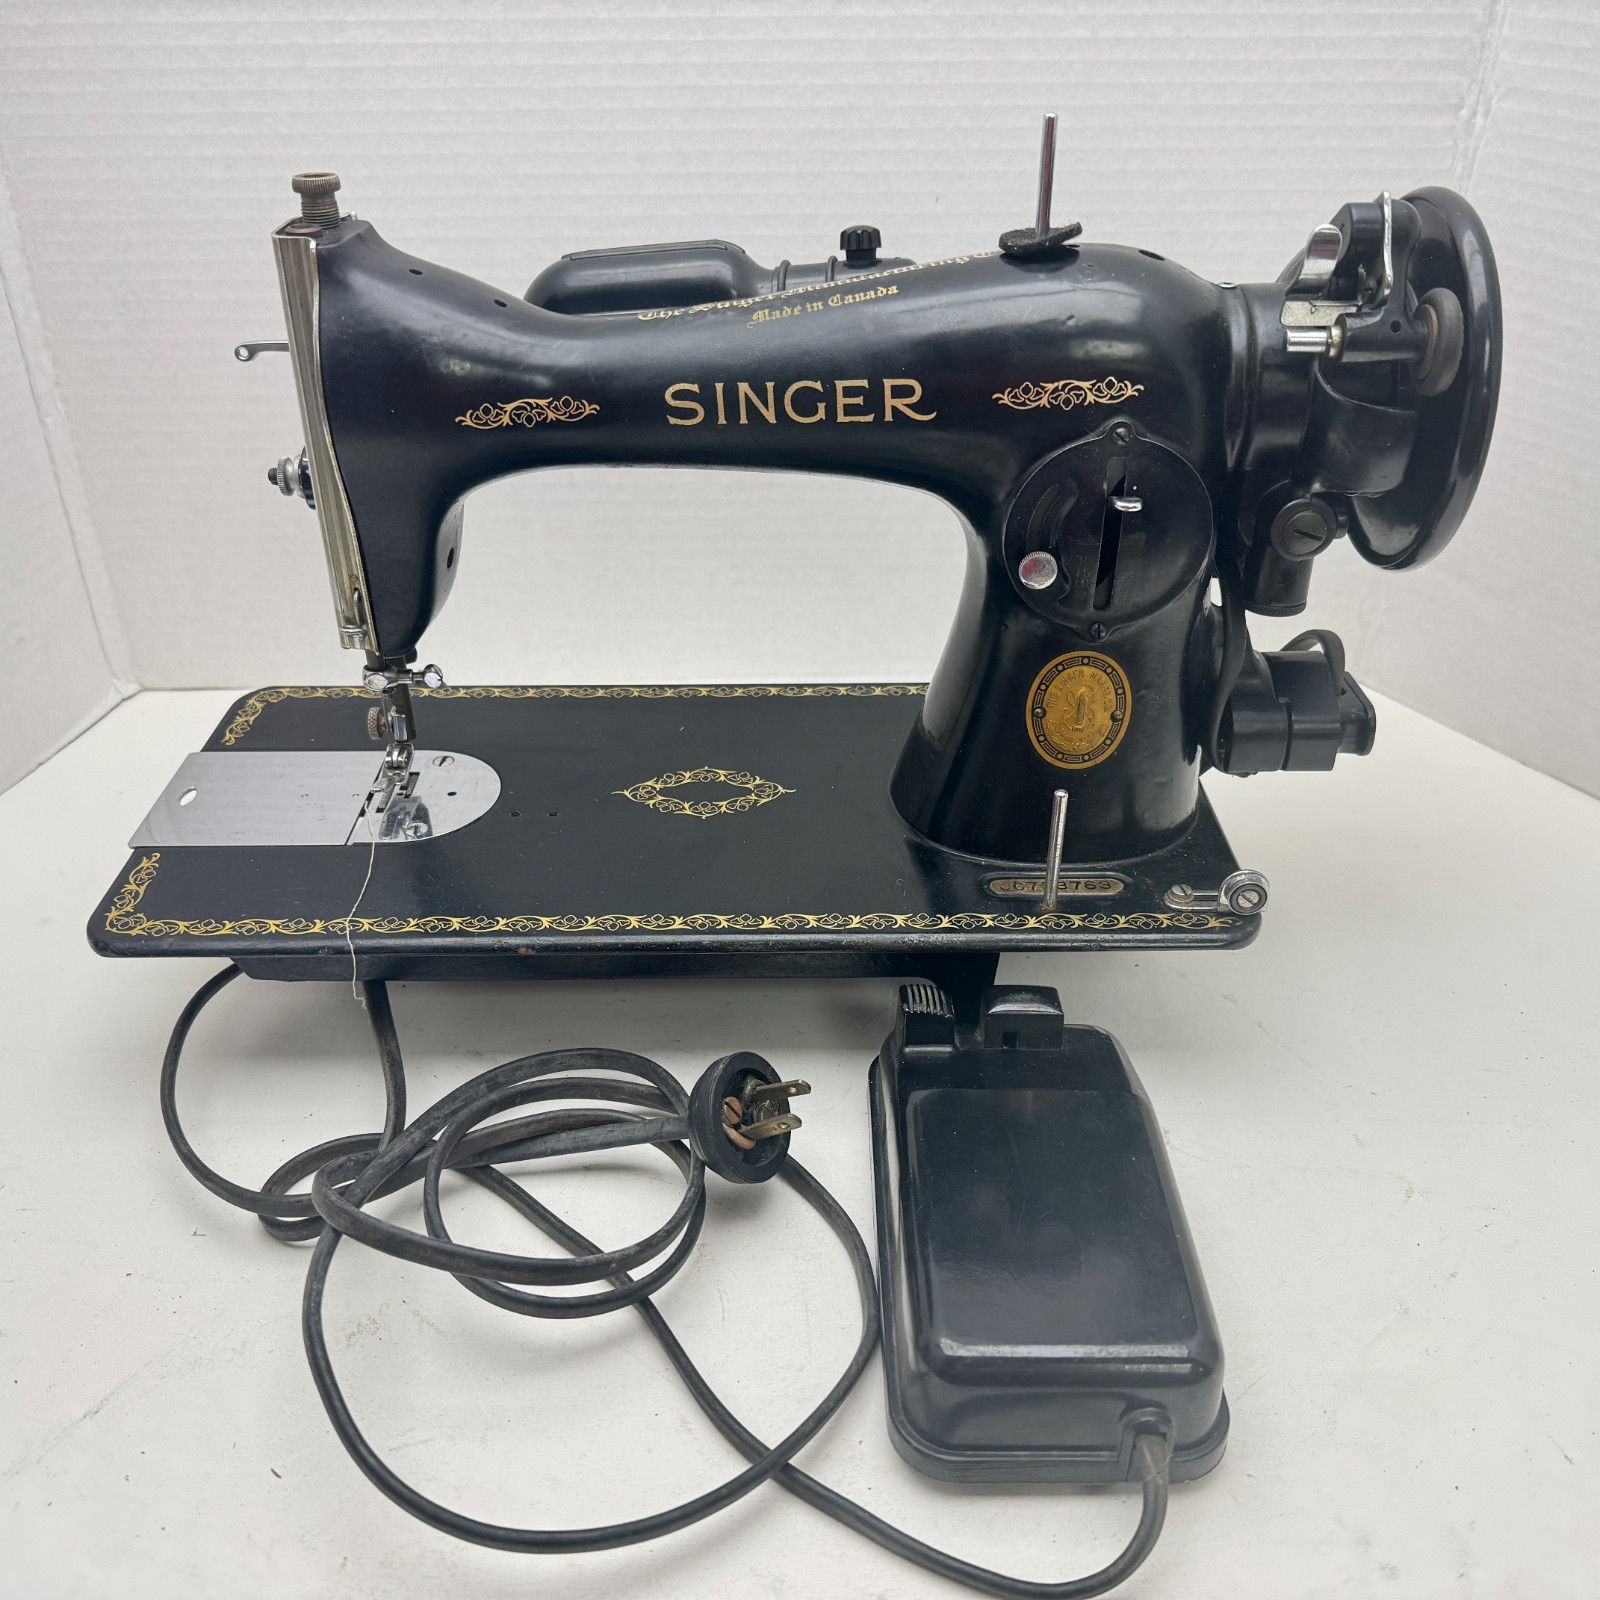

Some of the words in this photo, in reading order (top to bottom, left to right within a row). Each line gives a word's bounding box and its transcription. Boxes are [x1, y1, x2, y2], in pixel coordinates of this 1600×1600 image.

[746, 304, 802, 329] Made
[805, 301, 825, 314] in
[827, 285, 900, 307] Canada
[664, 378, 938, 426] SINGER
